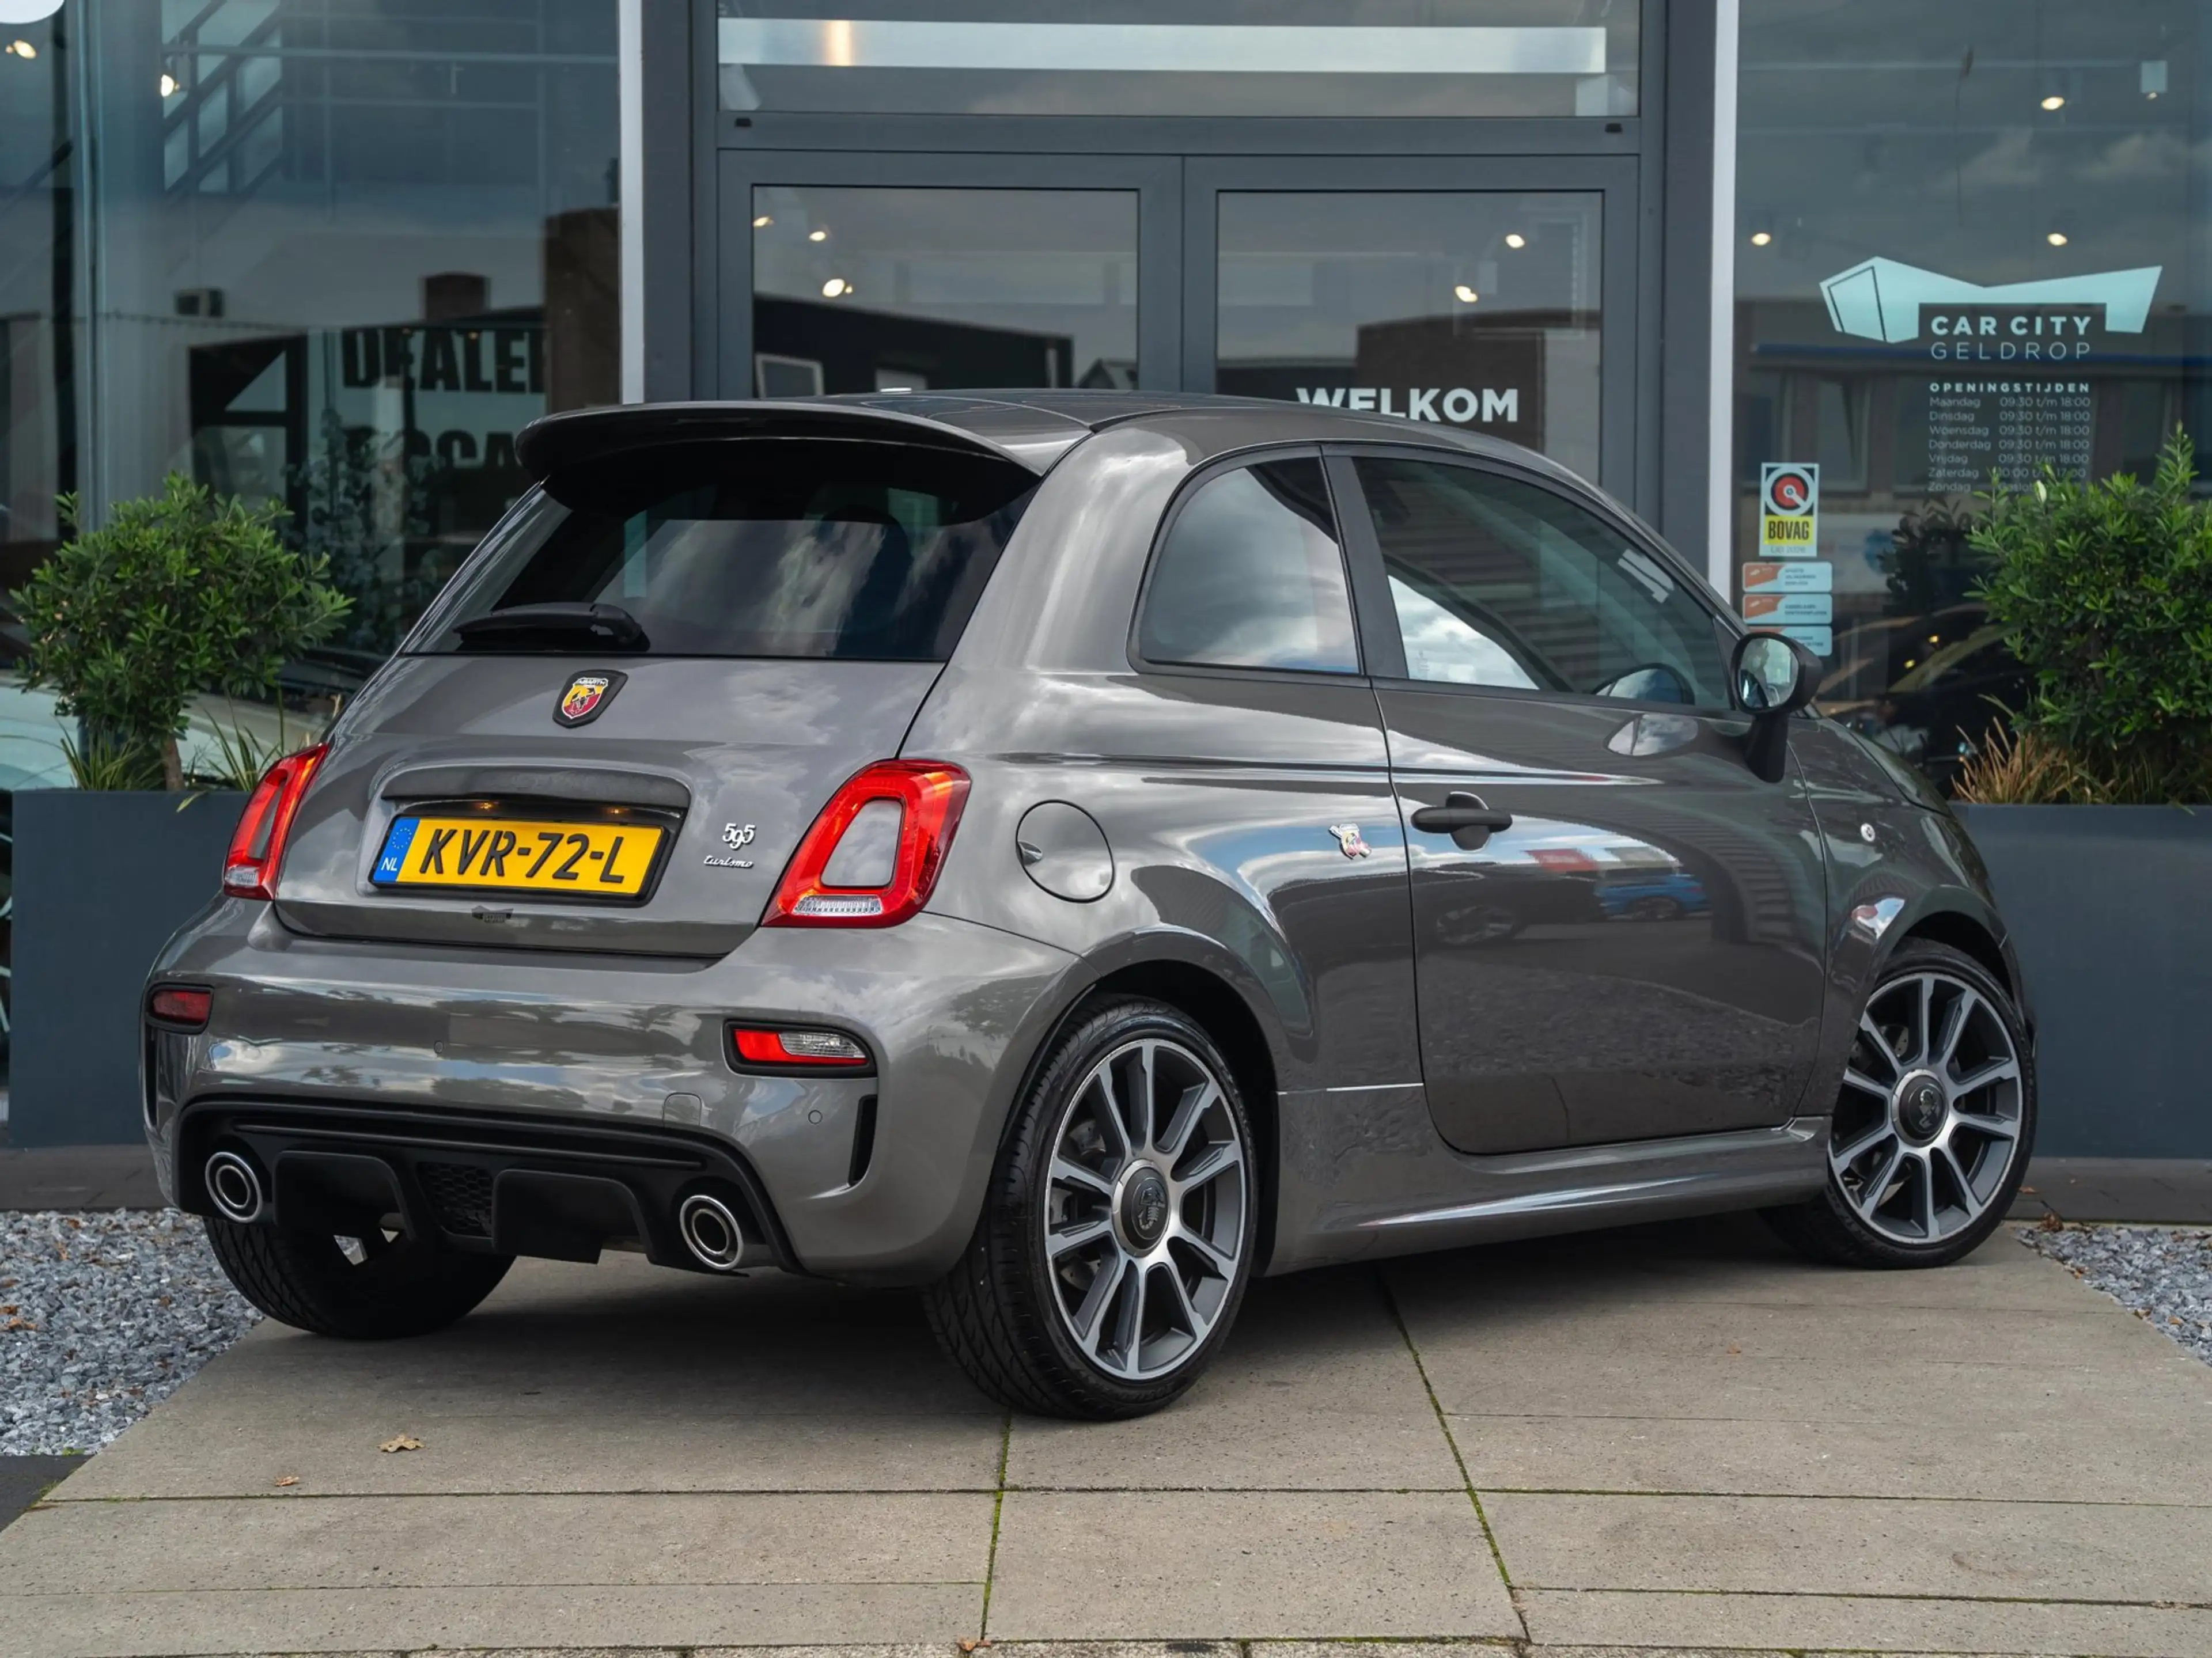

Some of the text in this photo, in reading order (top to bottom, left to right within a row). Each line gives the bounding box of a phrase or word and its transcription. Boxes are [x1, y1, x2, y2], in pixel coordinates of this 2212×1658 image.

[1931, 316, 2092, 336] CAR CITY
[1931, 342, 2090, 359] GELDROP
[1929, 382, 2090, 393] OPENINGSTIJDEN
[1296, 388, 1518, 423] WELKOM
[1768, 521, 1809, 540] BOVAG
[381, 829, 624, 883] NL KVR-72-L
